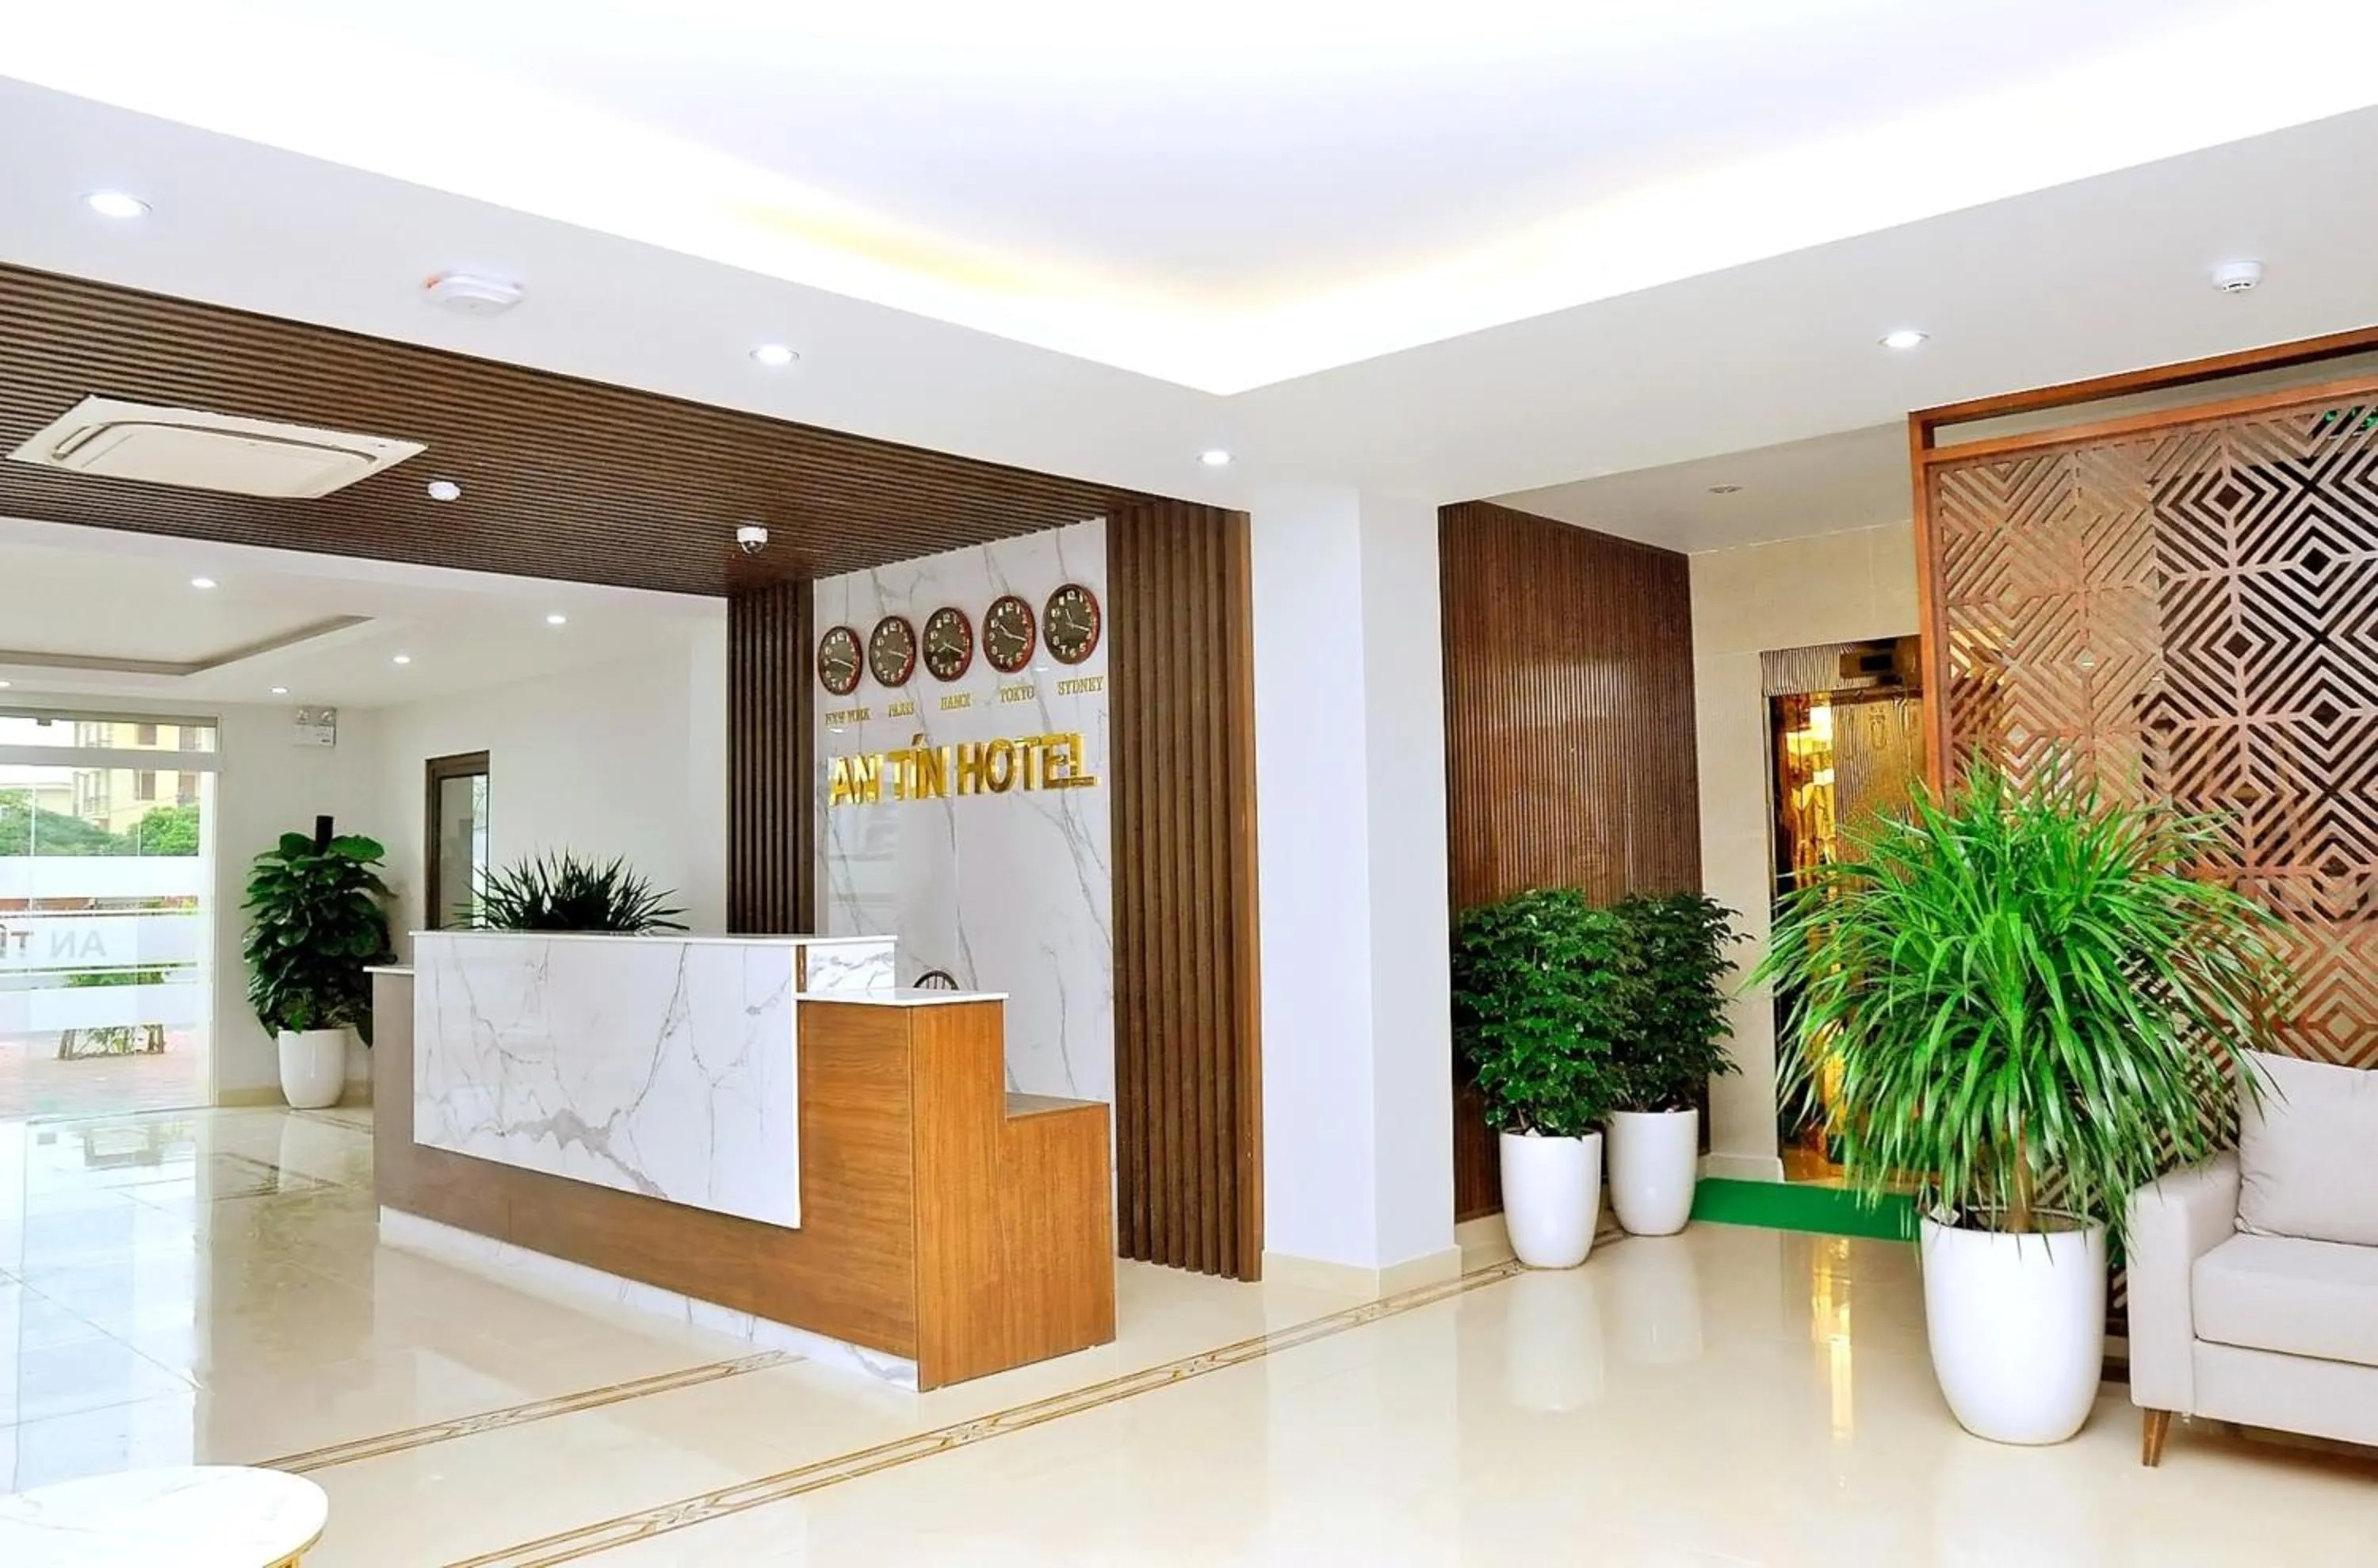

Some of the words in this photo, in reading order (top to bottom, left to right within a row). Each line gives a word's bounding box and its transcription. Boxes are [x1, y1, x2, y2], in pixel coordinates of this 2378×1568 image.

[1000, 684, 1035, 703] TOKYO
[1057, 675, 1103, 696] SYDNEY
[828, 754, 884, 805] AN
[888, 732, 952, 801] TÍN
[957, 732, 1101, 796] HOTEL
